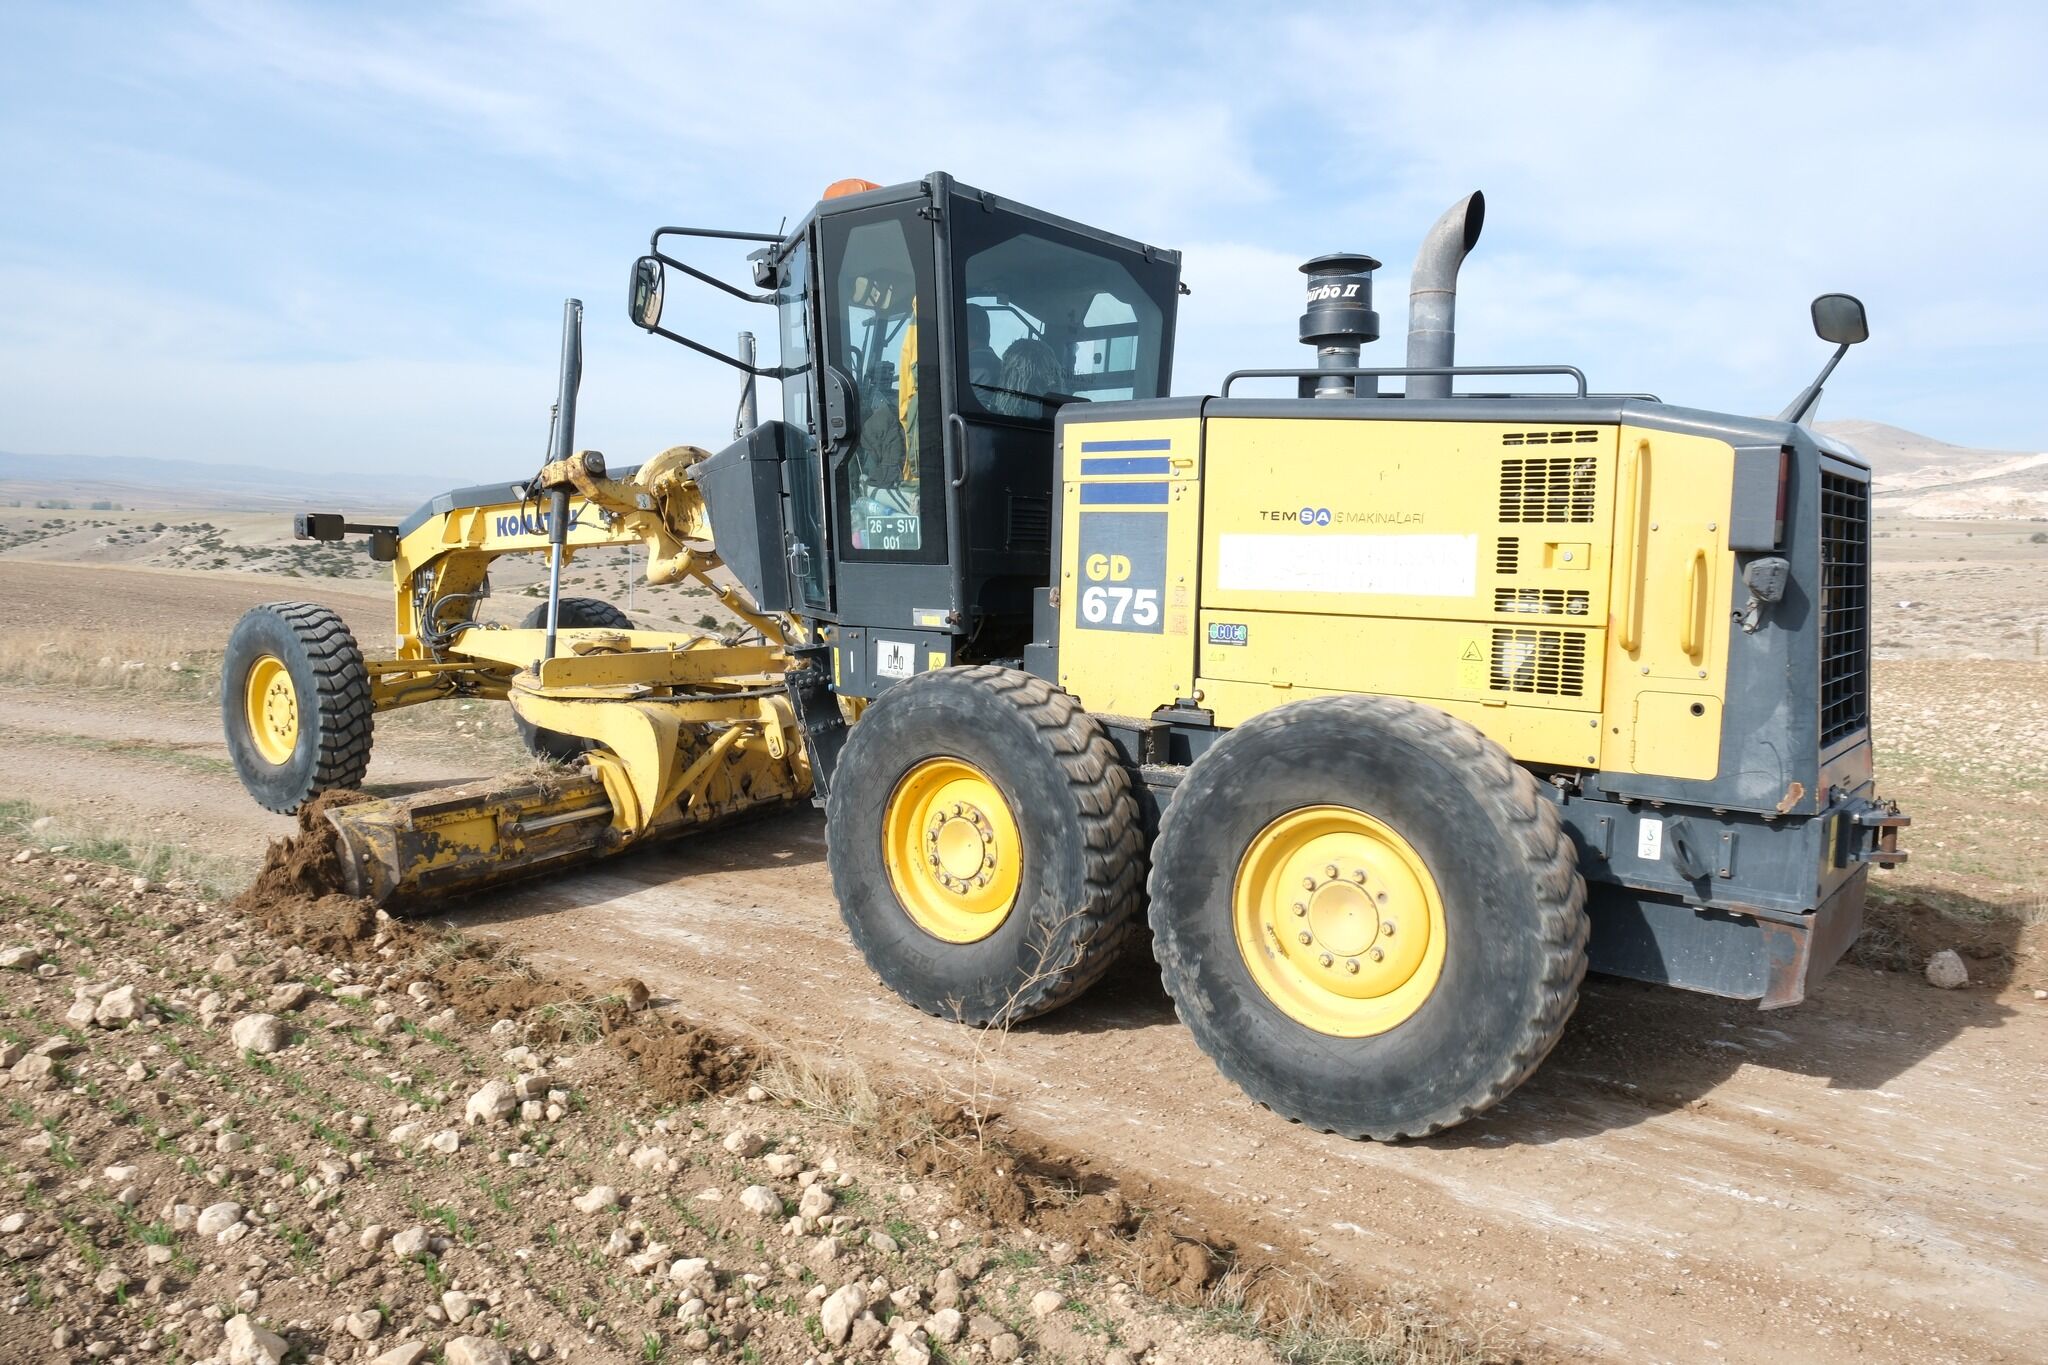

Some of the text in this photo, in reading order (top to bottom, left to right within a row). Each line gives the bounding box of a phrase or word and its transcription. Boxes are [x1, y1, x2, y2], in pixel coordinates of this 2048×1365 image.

[1259, 507, 1331, 526] TEMSA
[869, 519, 882, 534] 26
[883, 536, 900, 550] 001
[1085, 553, 1131, 581] GD
[1082, 586, 1158, 626] 675
